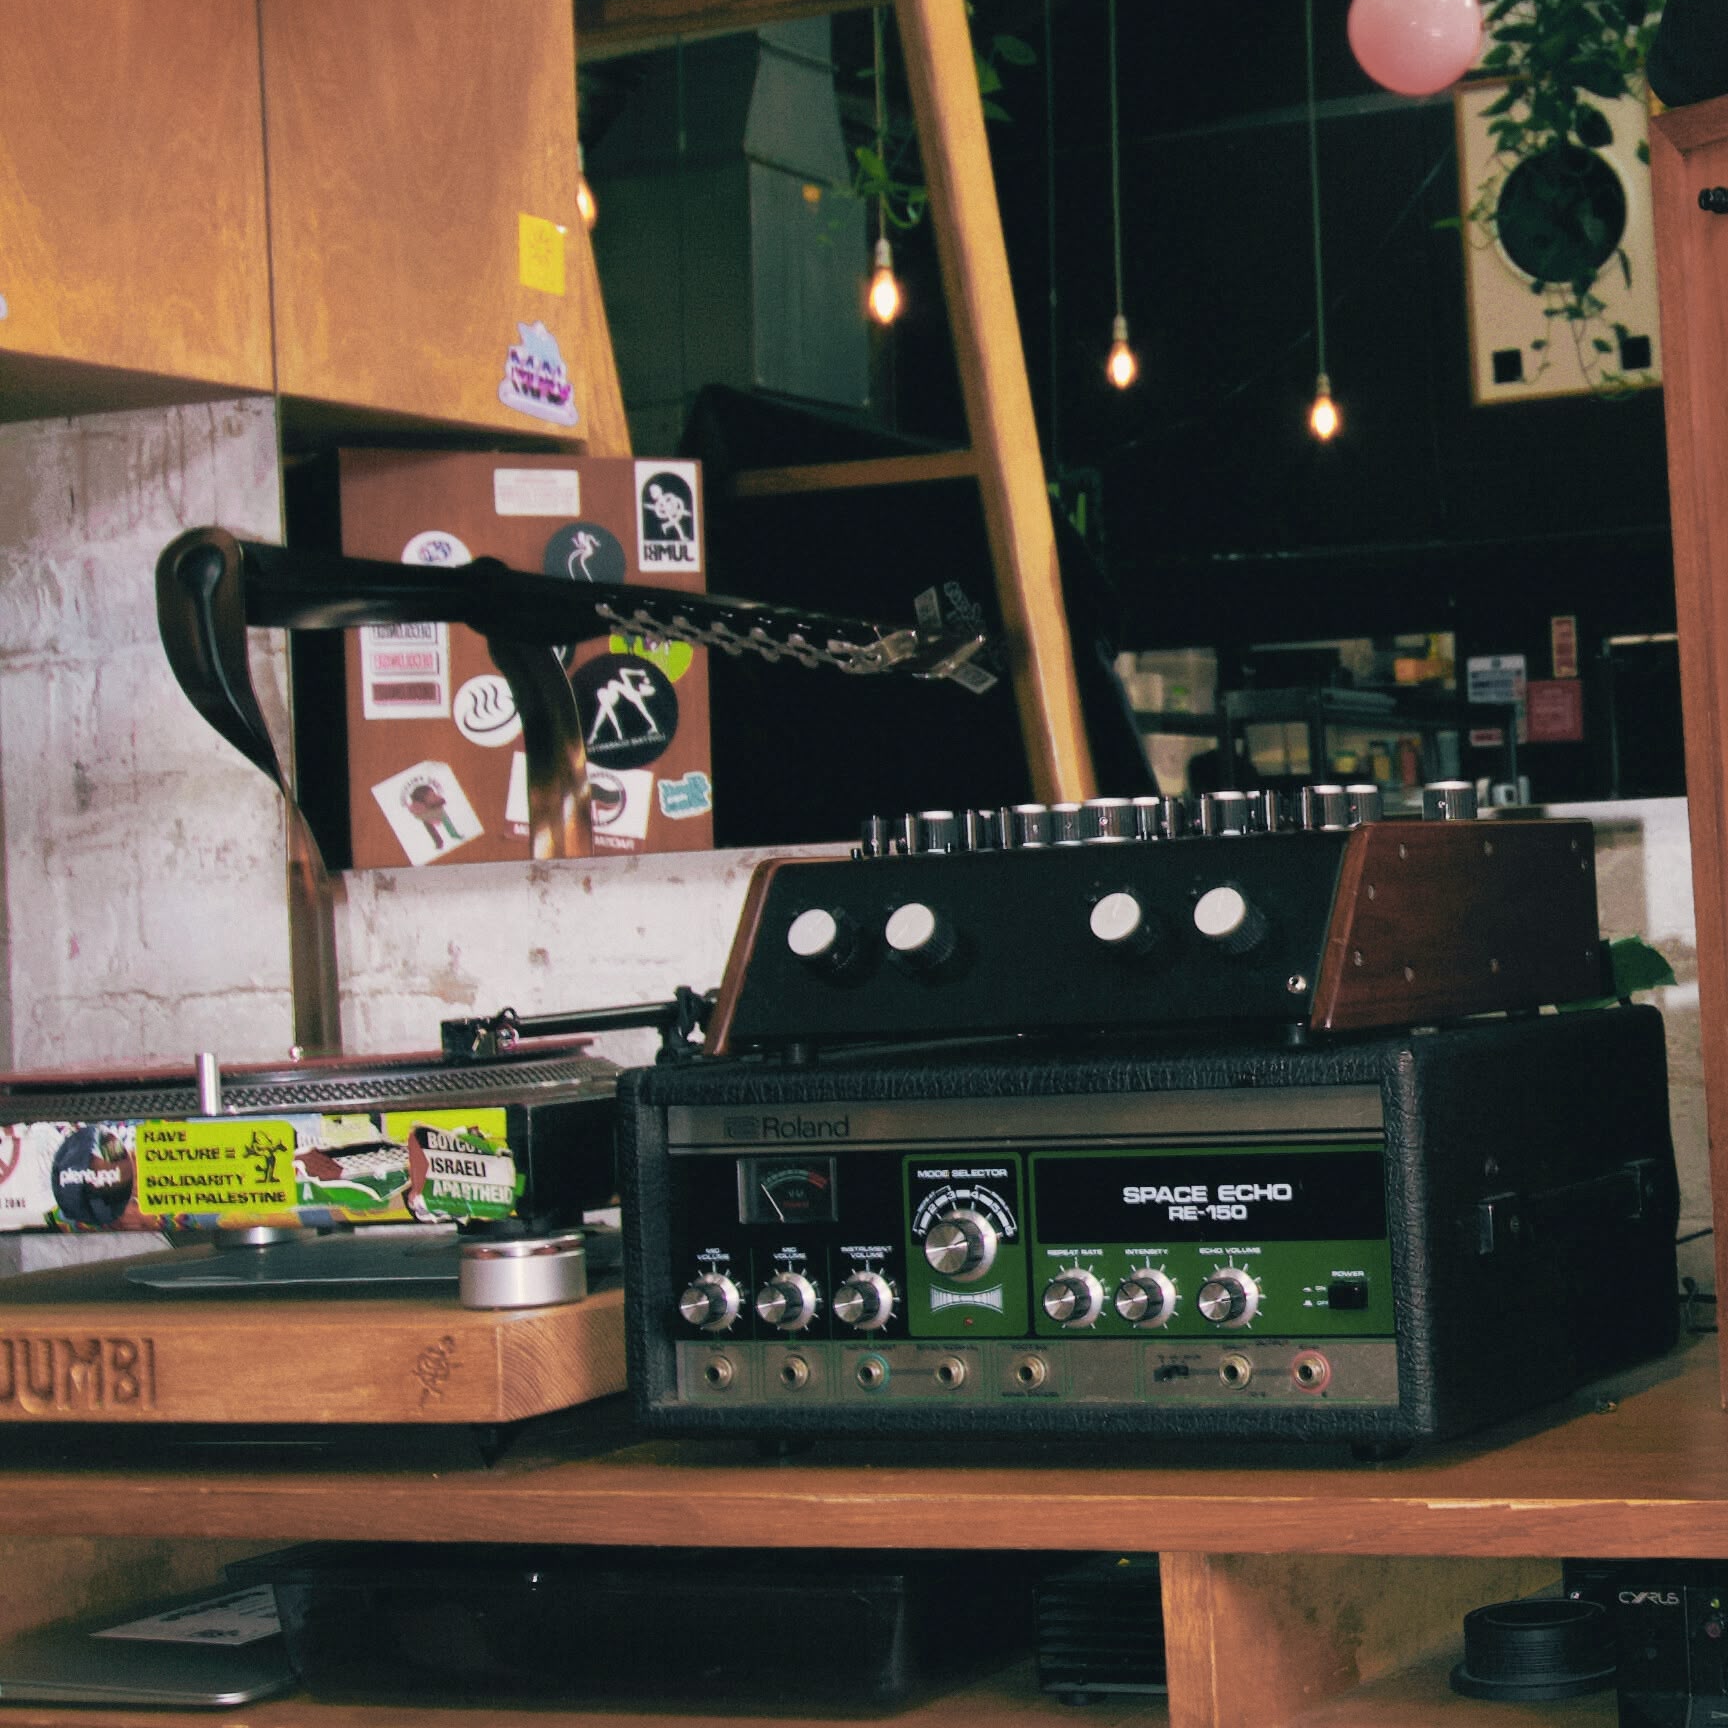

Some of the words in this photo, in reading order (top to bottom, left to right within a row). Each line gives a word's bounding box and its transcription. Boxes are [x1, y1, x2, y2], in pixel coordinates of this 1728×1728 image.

[762, 1115, 850, 1139] Roland
[143, 1130, 187, 1146] RAVE
[145, 1147, 220, 1163] CULTURE
[430, 1156, 488, 1178] ISRAELI
[917, 1169, 949, 1179] MODE
[951, 1168, 1008, 1178] SELECTOR
[147, 1174, 246, 1188] SOLIDARITY
[147, 1193, 193, 1206] WITH
[195, 1191, 288, 1205] PALESTINE
[432, 1179, 513, 1205] APARTHEID
[1122, 1186, 1208, 1204] SPACE
[1217, 1183, 1293, 1203] ECHO
[1168, 1204, 1248, 1222] RE-150
[697, 1253, 731, 1261] VOLUME
[773, 1252, 807, 1260] VOLUME
[850, 1251, 885, 1259] VOLUME
[1081, 1248, 1103, 1256] RATE
[1199, 1247, 1224, 1255] ECHO
[1225, 1246, 1262, 1255] VOLUME
[1619, 1591, 1681, 1605] CYRUS
